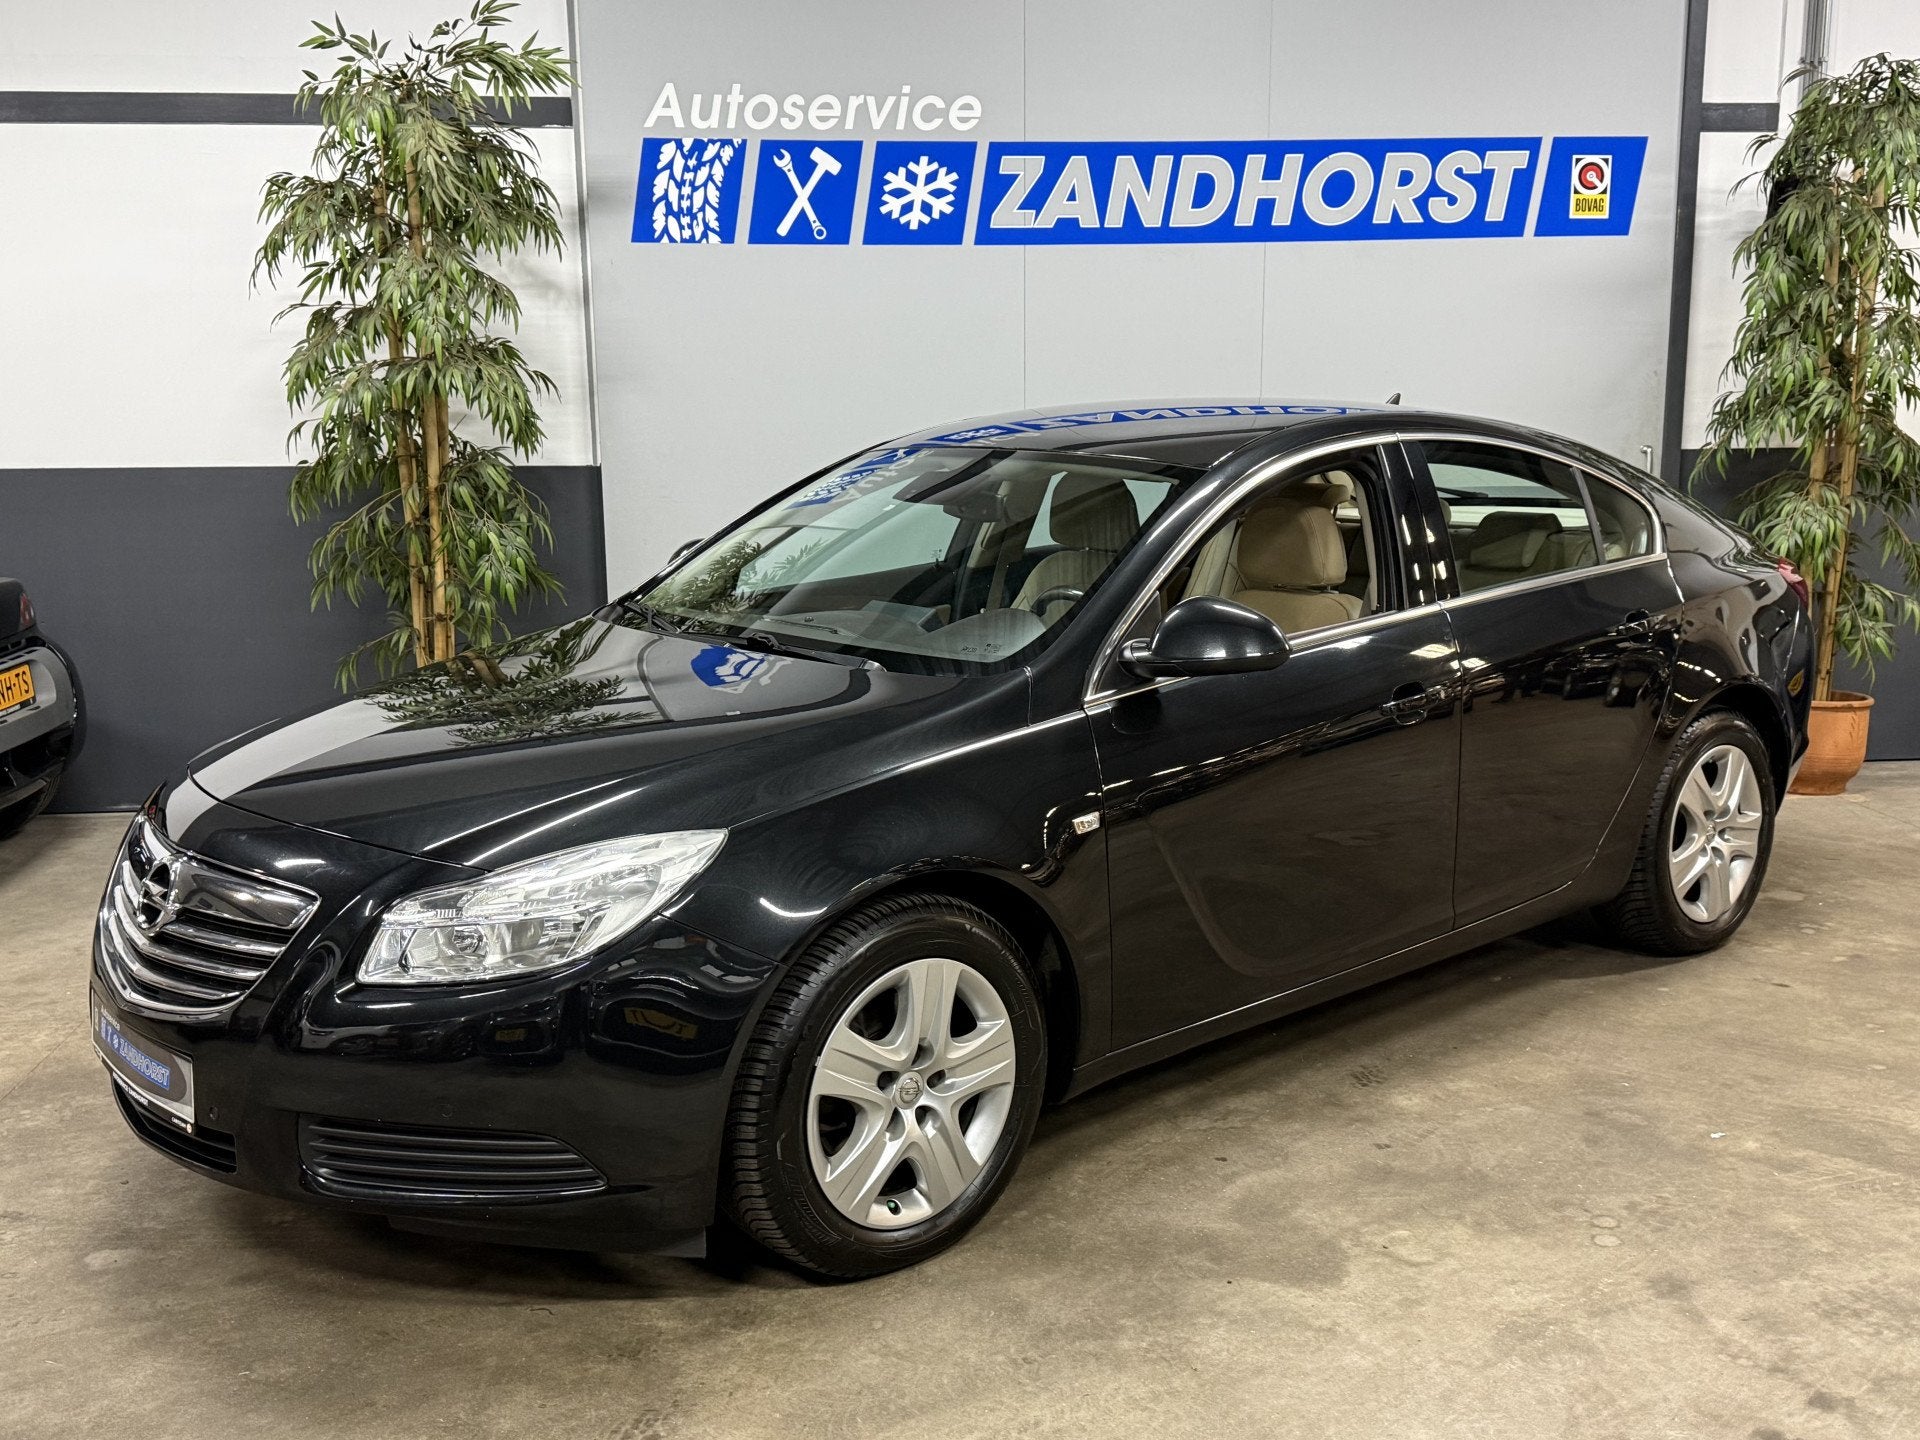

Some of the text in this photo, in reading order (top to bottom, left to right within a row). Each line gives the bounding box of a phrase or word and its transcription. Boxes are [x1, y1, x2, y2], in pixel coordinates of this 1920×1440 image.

[643, 82, 982, 131] Autoservice
[989, 150, 1530, 230] ZANDHORST
[1575, 197, 1605, 212] BOVAG
